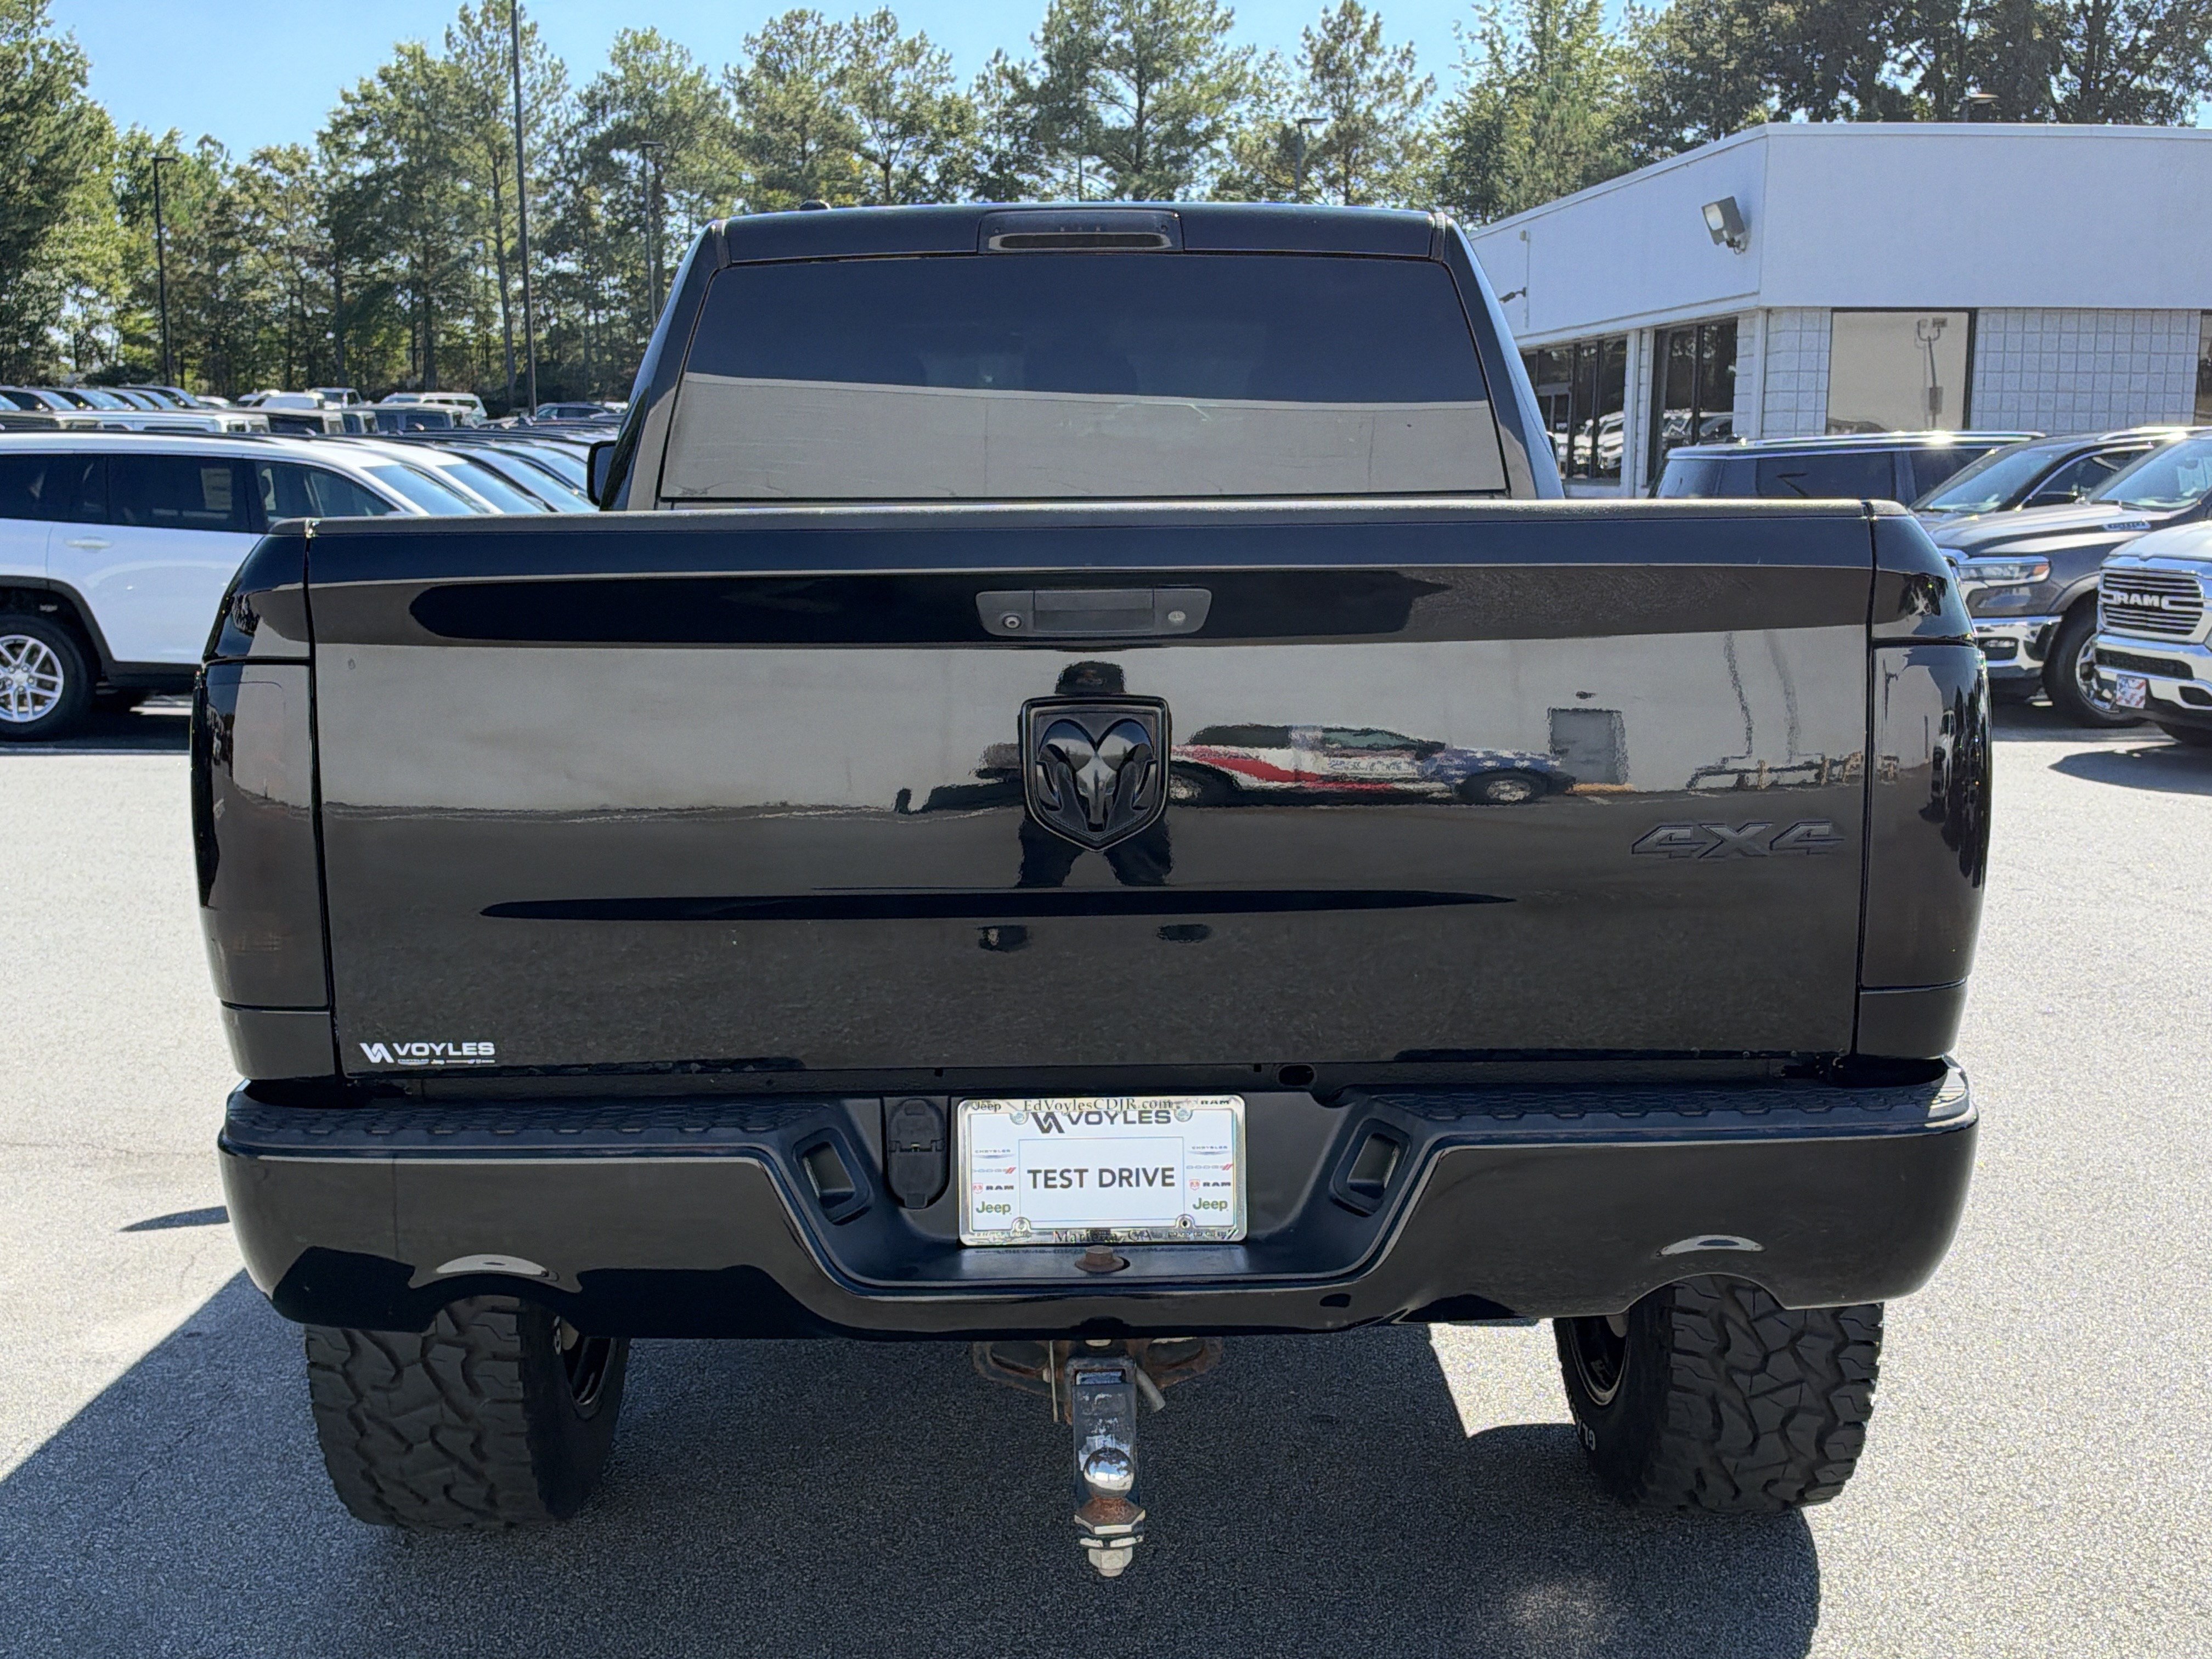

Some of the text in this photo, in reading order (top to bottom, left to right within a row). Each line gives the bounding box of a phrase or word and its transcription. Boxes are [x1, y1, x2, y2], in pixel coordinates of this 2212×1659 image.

[2116, 592, 2160, 607] RAM
[392, 1042, 495, 1056] VOYLES
[972, 1101, 1001, 1112] Jeep
[1024, 1098, 1173, 1115] EdVoylesCDJR.com
[1068, 1110, 1171, 1125] VOYLES
[1027, 1167, 1175, 1189] TEST DRIVE
[976, 1201, 1011, 1215] Jeep
[1192, 1197, 1228, 1211] Jeep
